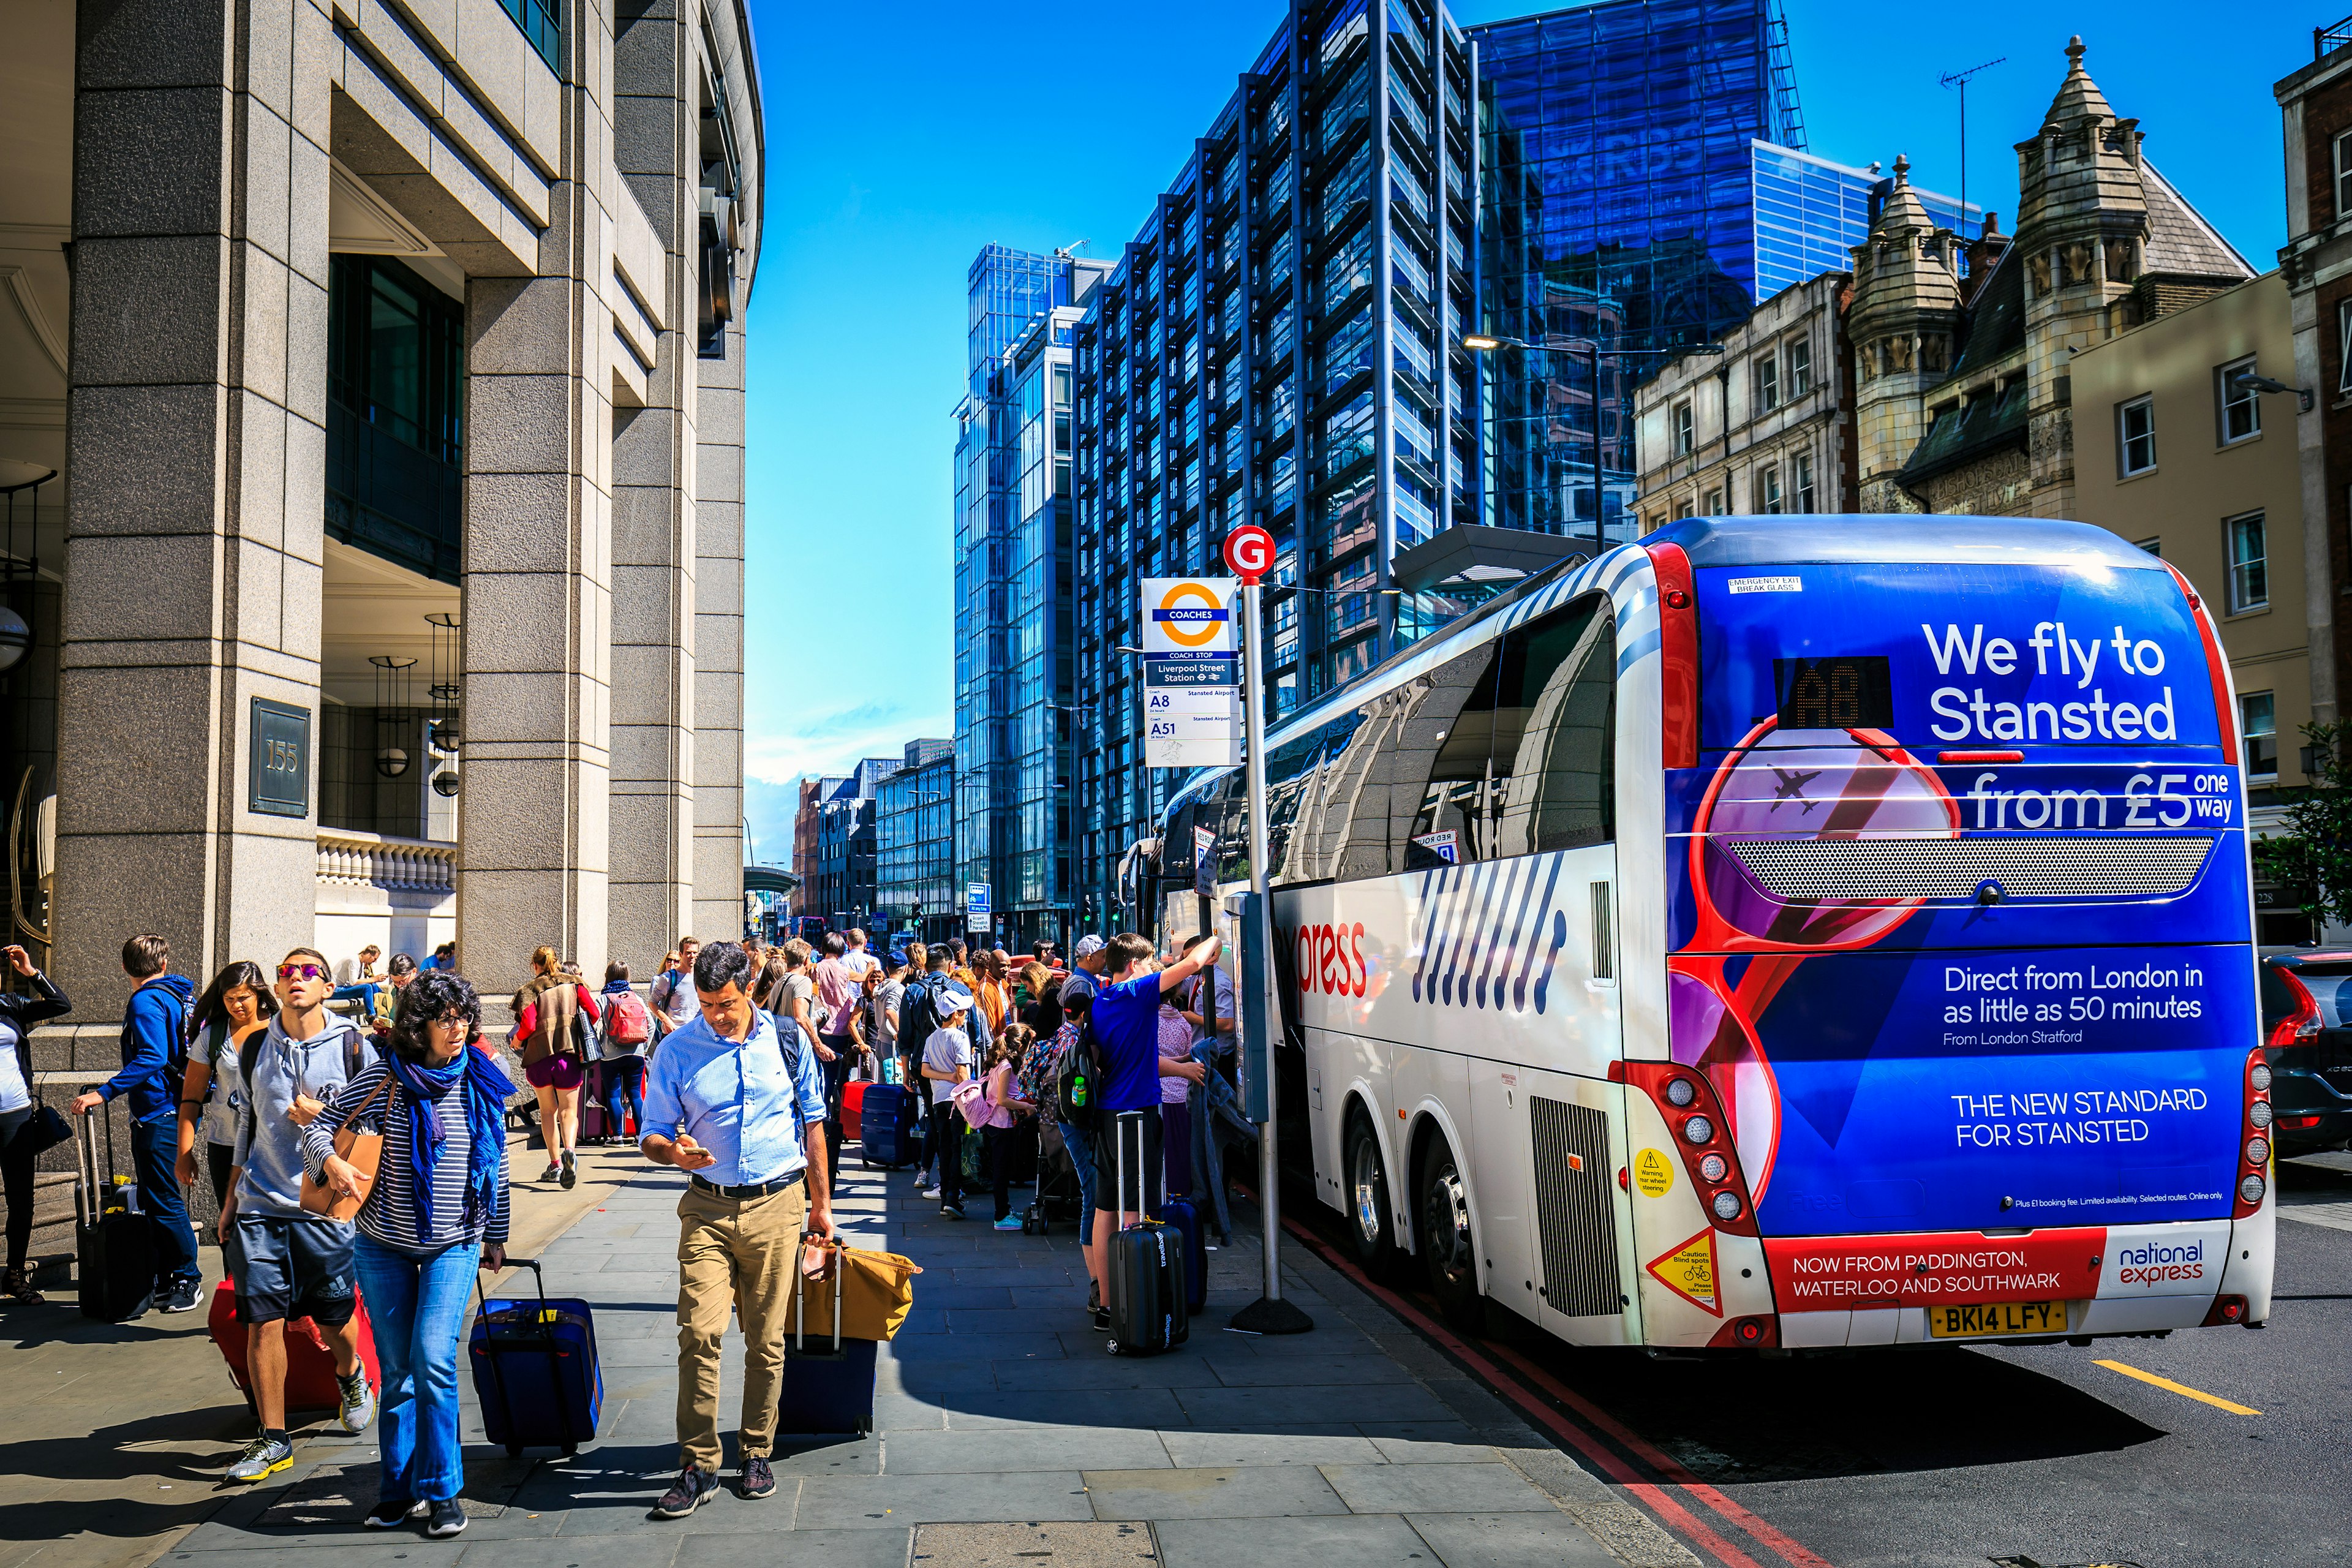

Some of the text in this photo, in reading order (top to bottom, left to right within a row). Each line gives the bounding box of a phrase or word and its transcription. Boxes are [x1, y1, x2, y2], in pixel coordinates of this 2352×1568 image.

[1232, 533, 1265, 570] G
[1729, 578, 1779, 586] EMERGENCY
[1921, 621, 2165, 689] We fly to
[1158, 665, 1197, 674] Liverpool
[1150, 695, 1170, 707] A8
[1797, 666, 1858, 726] A8
[1930, 686, 2177, 741] Stansted
[1151, 723, 1175, 735] A51
[266, 739, 298, 773] 155
[2194, 774, 2228, 793] one
[1967, 772, 2192, 829] from £5
[2195, 800, 2233, 823] way
[2258, 893, 2273, 903] 228
[1945, 963, 2203, 992] Direct from London in
[1943, 995, 2202, 1023] as little as 50 minutes
[1943, 1030, 2082, 1046] From London Stratford
[1951, 1088, 2207, 1118] THE NEW STANDARD
[1956, 1119, 2149, 1147] FOR STANSTED
[2039, 1198, 2067, 1208] booking
[2080, 1197, 2105, 1205] Limited
[2106, 1196, 2138, 1205] availability.
[2210, 1191, 2223, 1200] only.
[1793, 1251, 2027, 1273] NOW FROM PADDINGTON,
[2120, 1239, 2203, 1265] national
[1793, 1279, 1899, 1296] WATERLOO
[1901, 1277, 1941, 1294] AND
[1945, 1273, 2060, 1292] SOUTHWARK
[2120, 1264, 2203, 1288] express
[317, 1288, 351, 1298] adidas
[1945, 1305, 2051, 1332] BK14 LFY
